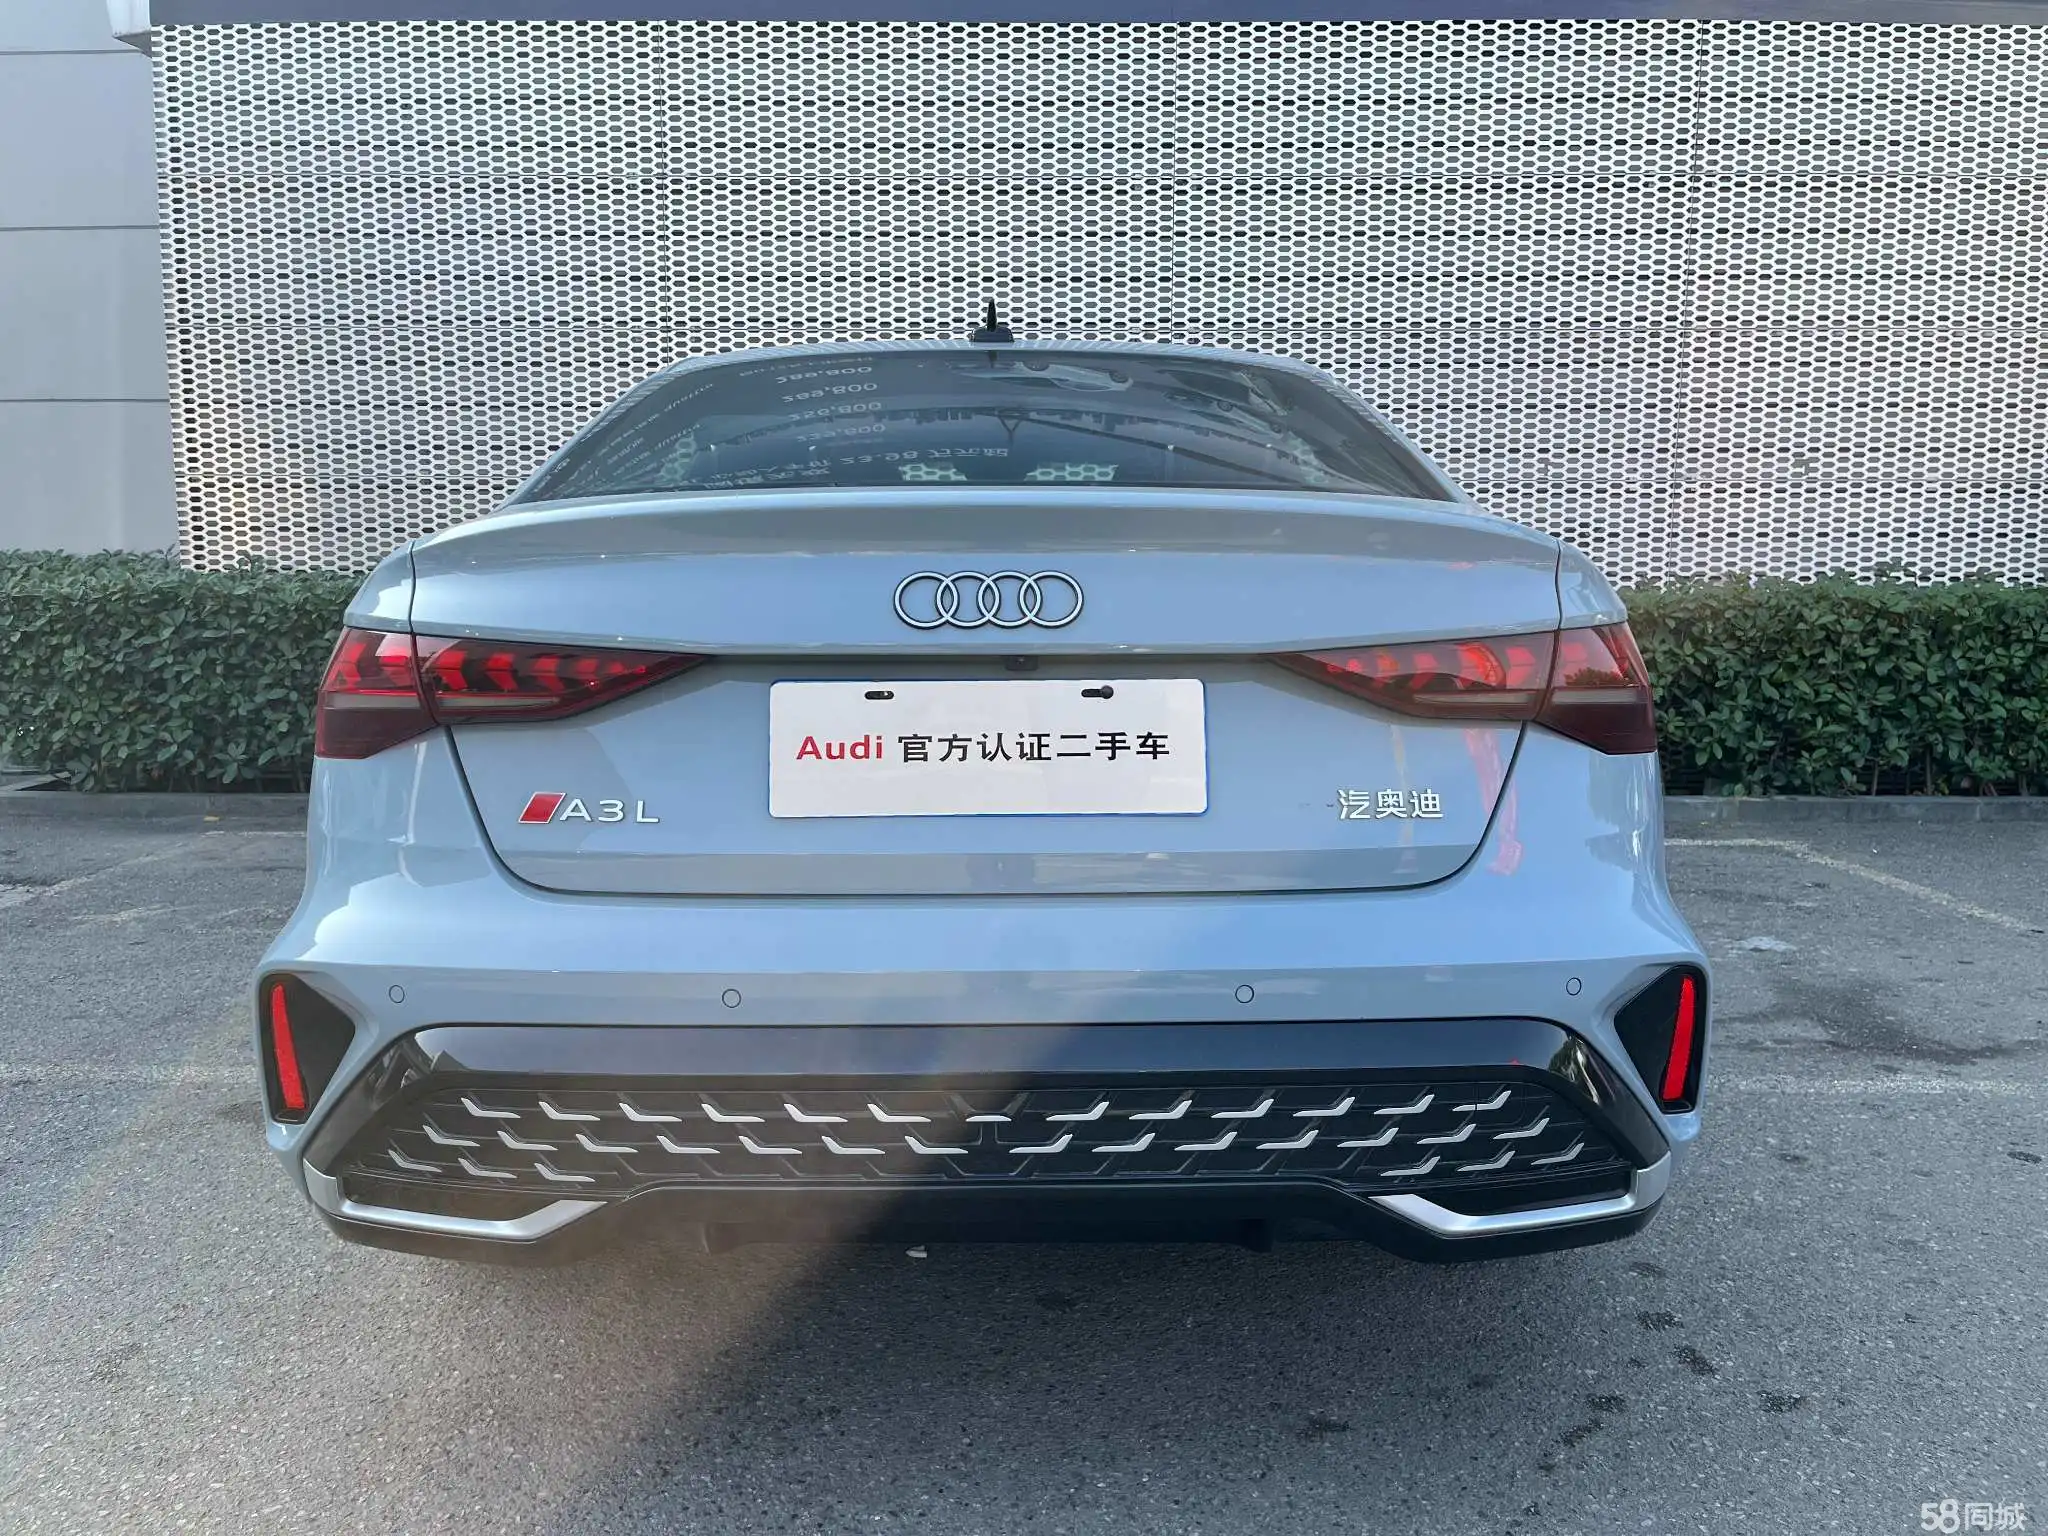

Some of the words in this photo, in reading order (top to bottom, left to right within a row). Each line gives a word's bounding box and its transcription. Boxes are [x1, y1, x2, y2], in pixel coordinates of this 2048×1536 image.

[796, 734, 884, 761] Audi
[897, 731, 1170, 764] 官方认证二手车
[1337, 788, 1445, 820] 汽奥迪
